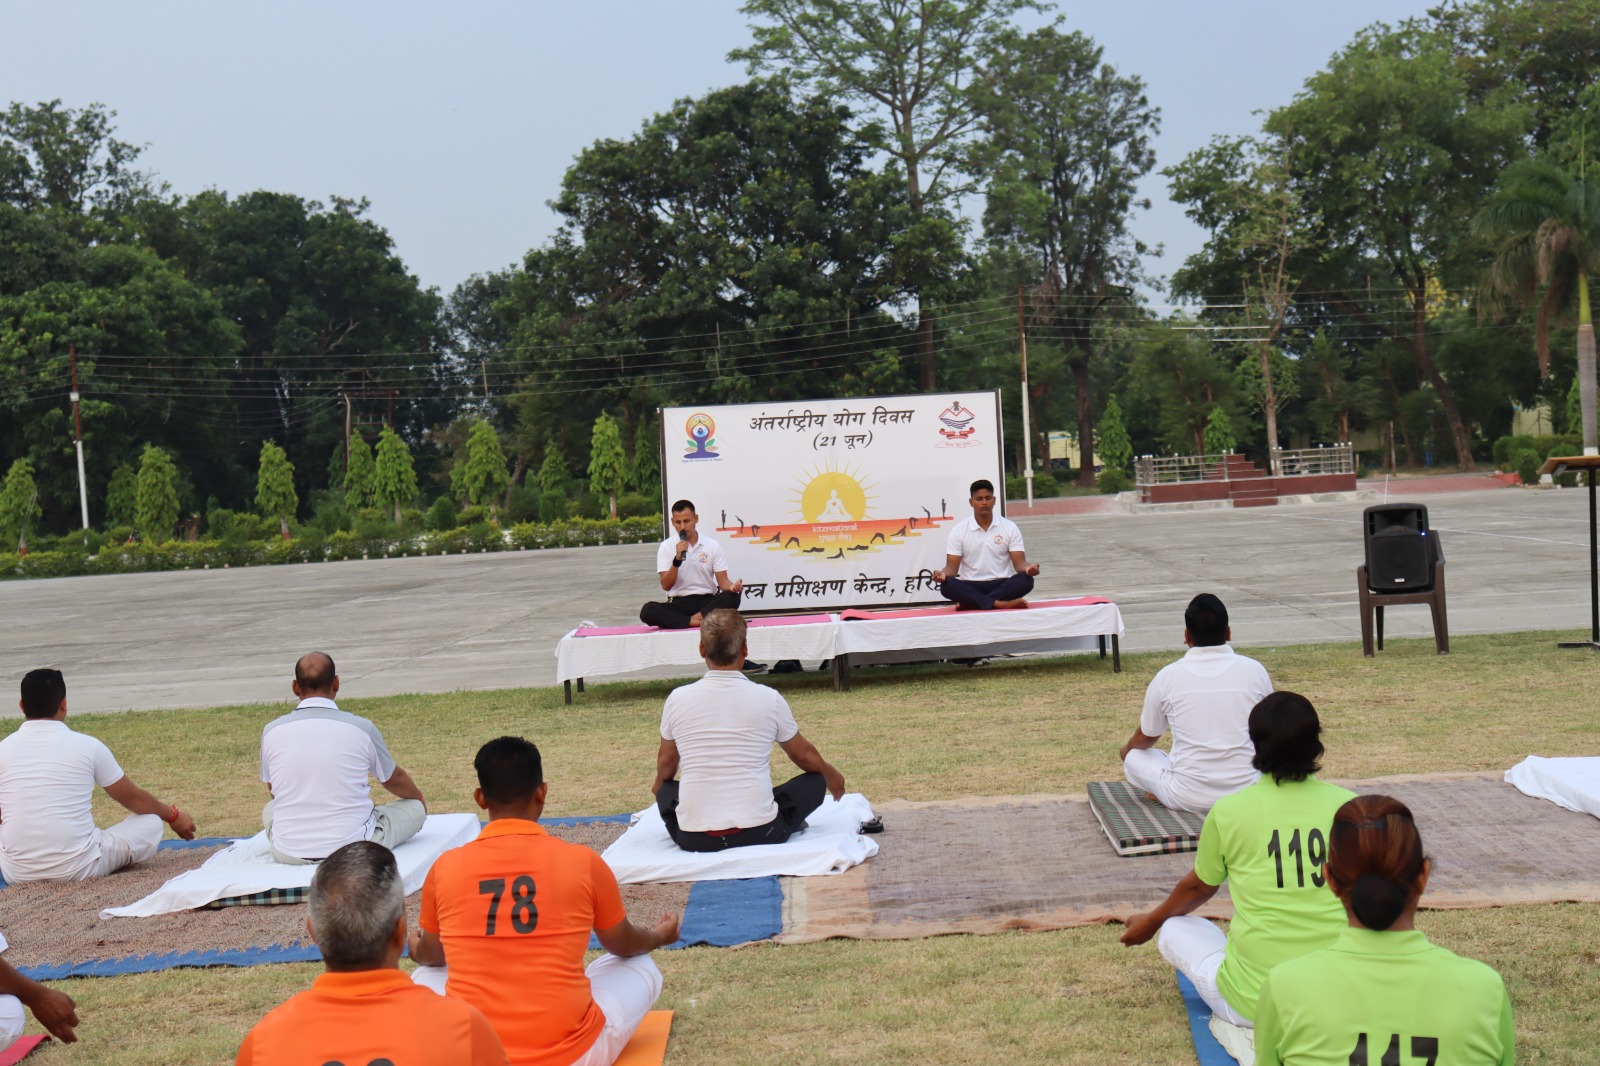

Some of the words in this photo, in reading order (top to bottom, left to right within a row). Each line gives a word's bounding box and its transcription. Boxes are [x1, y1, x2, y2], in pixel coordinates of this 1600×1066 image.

[750, 409, 827, 432] अंतर्राष्ट्रीय
[833, 408, 866, 427] योग
[872, 405, 915, 425] दिवस
[813, 431, 837, 450] (21
[844, 430, 873, 450] जून)
[774, 575, 847, 599] प्रशिक्षण
[1267, 828, 1327, 889] 119
[479, 875, 539, 936] 78
